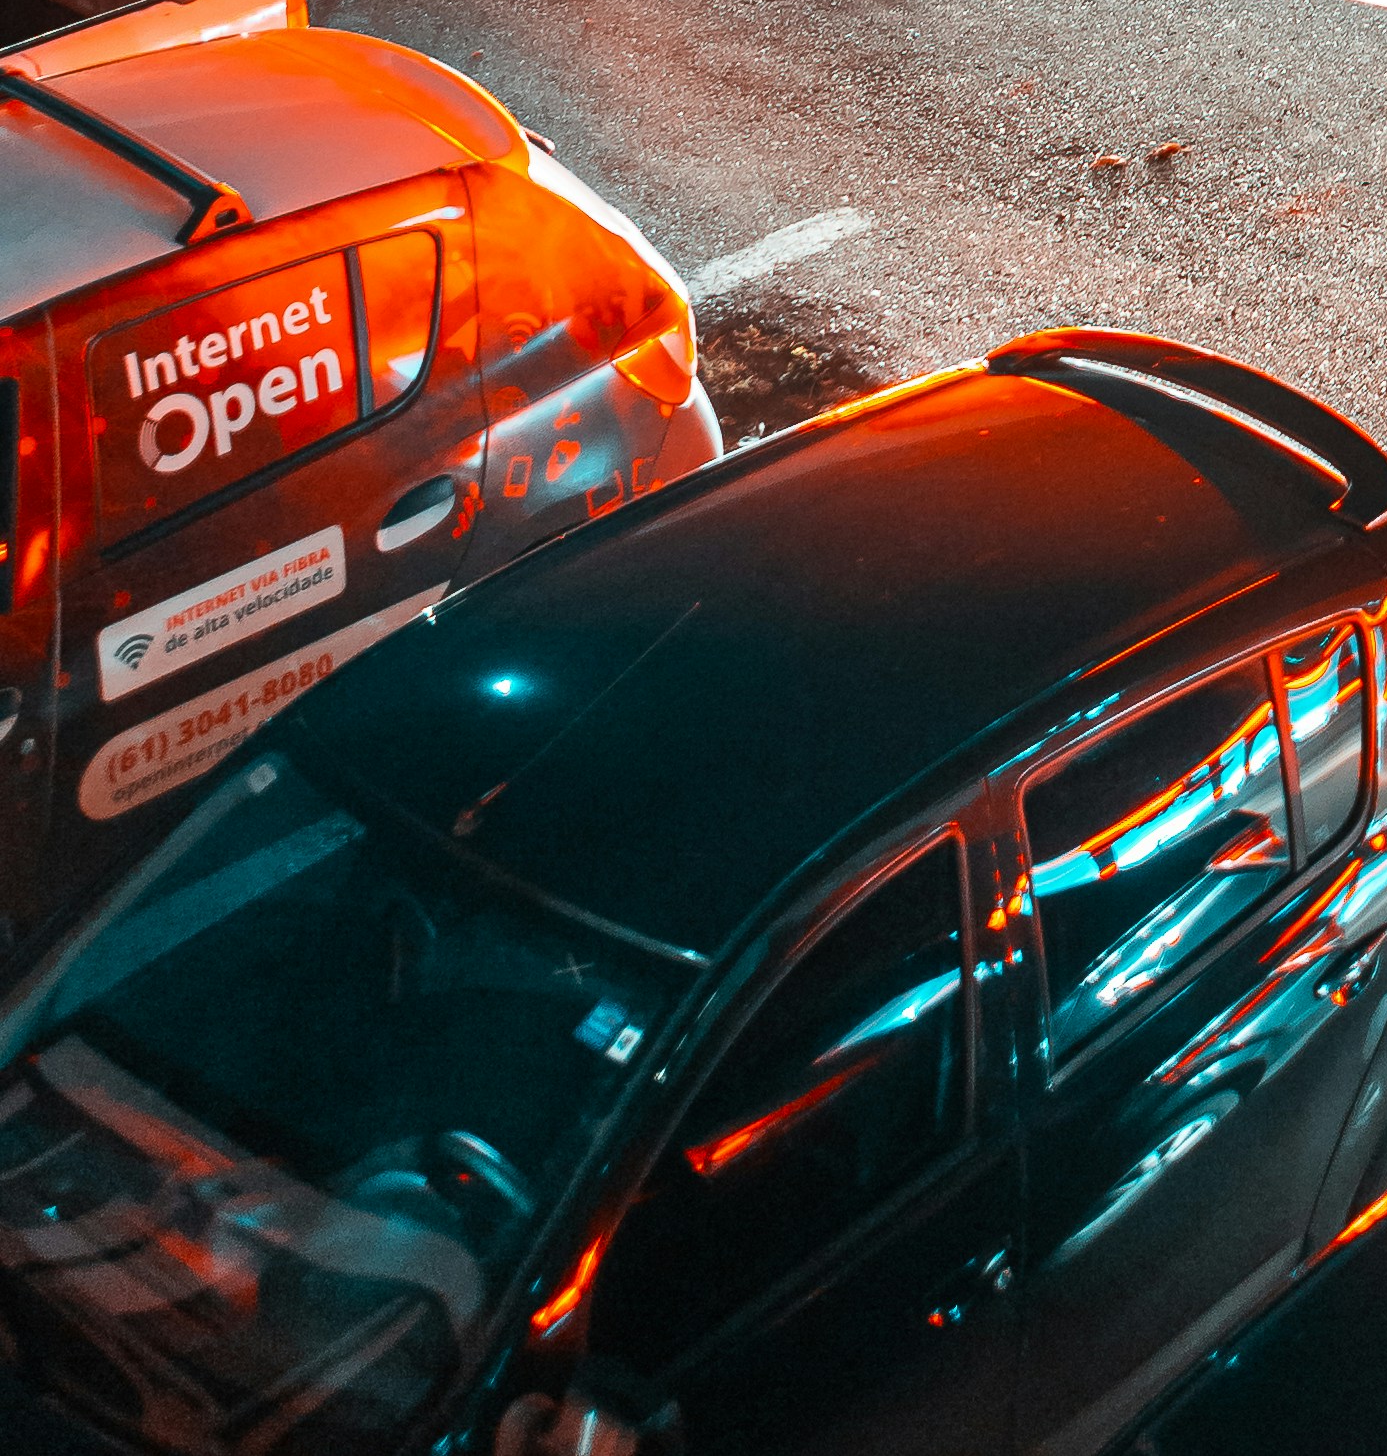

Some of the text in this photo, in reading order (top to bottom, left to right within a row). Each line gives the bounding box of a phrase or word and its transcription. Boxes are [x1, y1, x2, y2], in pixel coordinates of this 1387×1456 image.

[124, 286, 332, 399] Internet
[139, 347, 343, 472] Open
[164, 547, 332, 633] INTERNET VIA FIBRA
[164, 565, 335, 654] de alta velocidade
[106, 652, 334, 784] (61) 3041-8080
